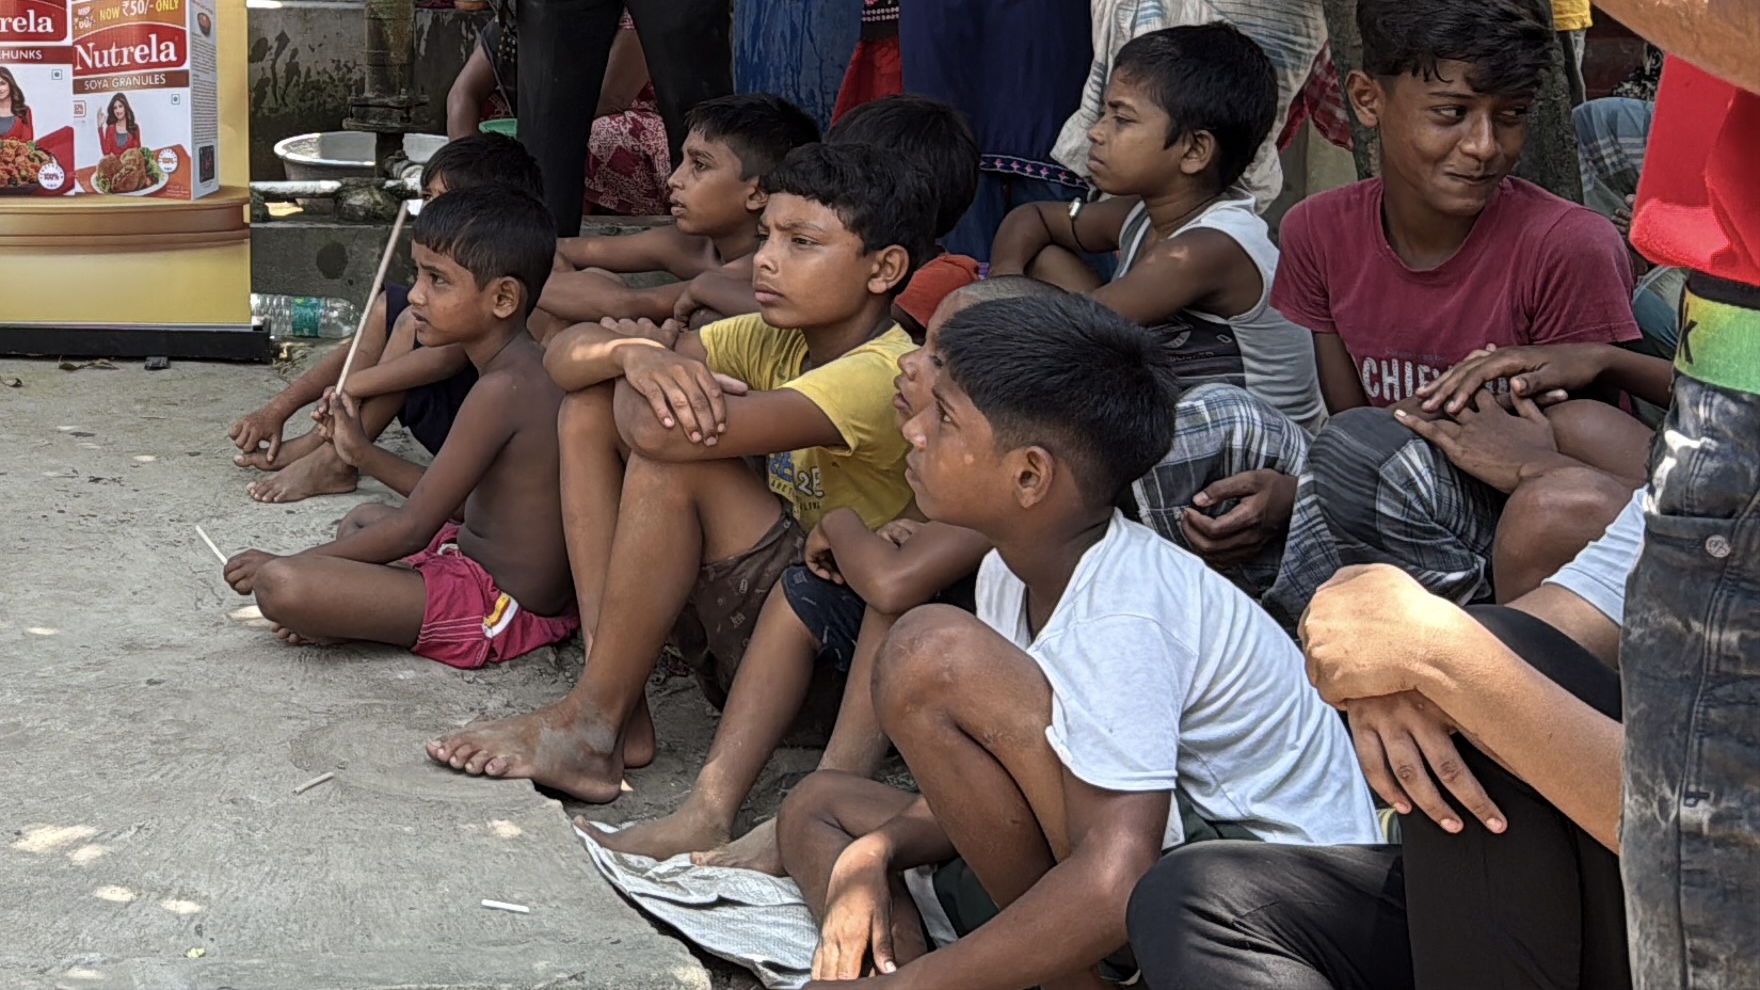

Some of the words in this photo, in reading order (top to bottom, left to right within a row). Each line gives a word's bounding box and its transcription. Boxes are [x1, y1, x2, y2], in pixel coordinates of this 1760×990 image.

[99, 6, 120, 21] NOW
[73, 33, 178, 71] Nutrela
[84, 77, 110, 91] SOYA
[111, 73, 167, 89] GRANULES
